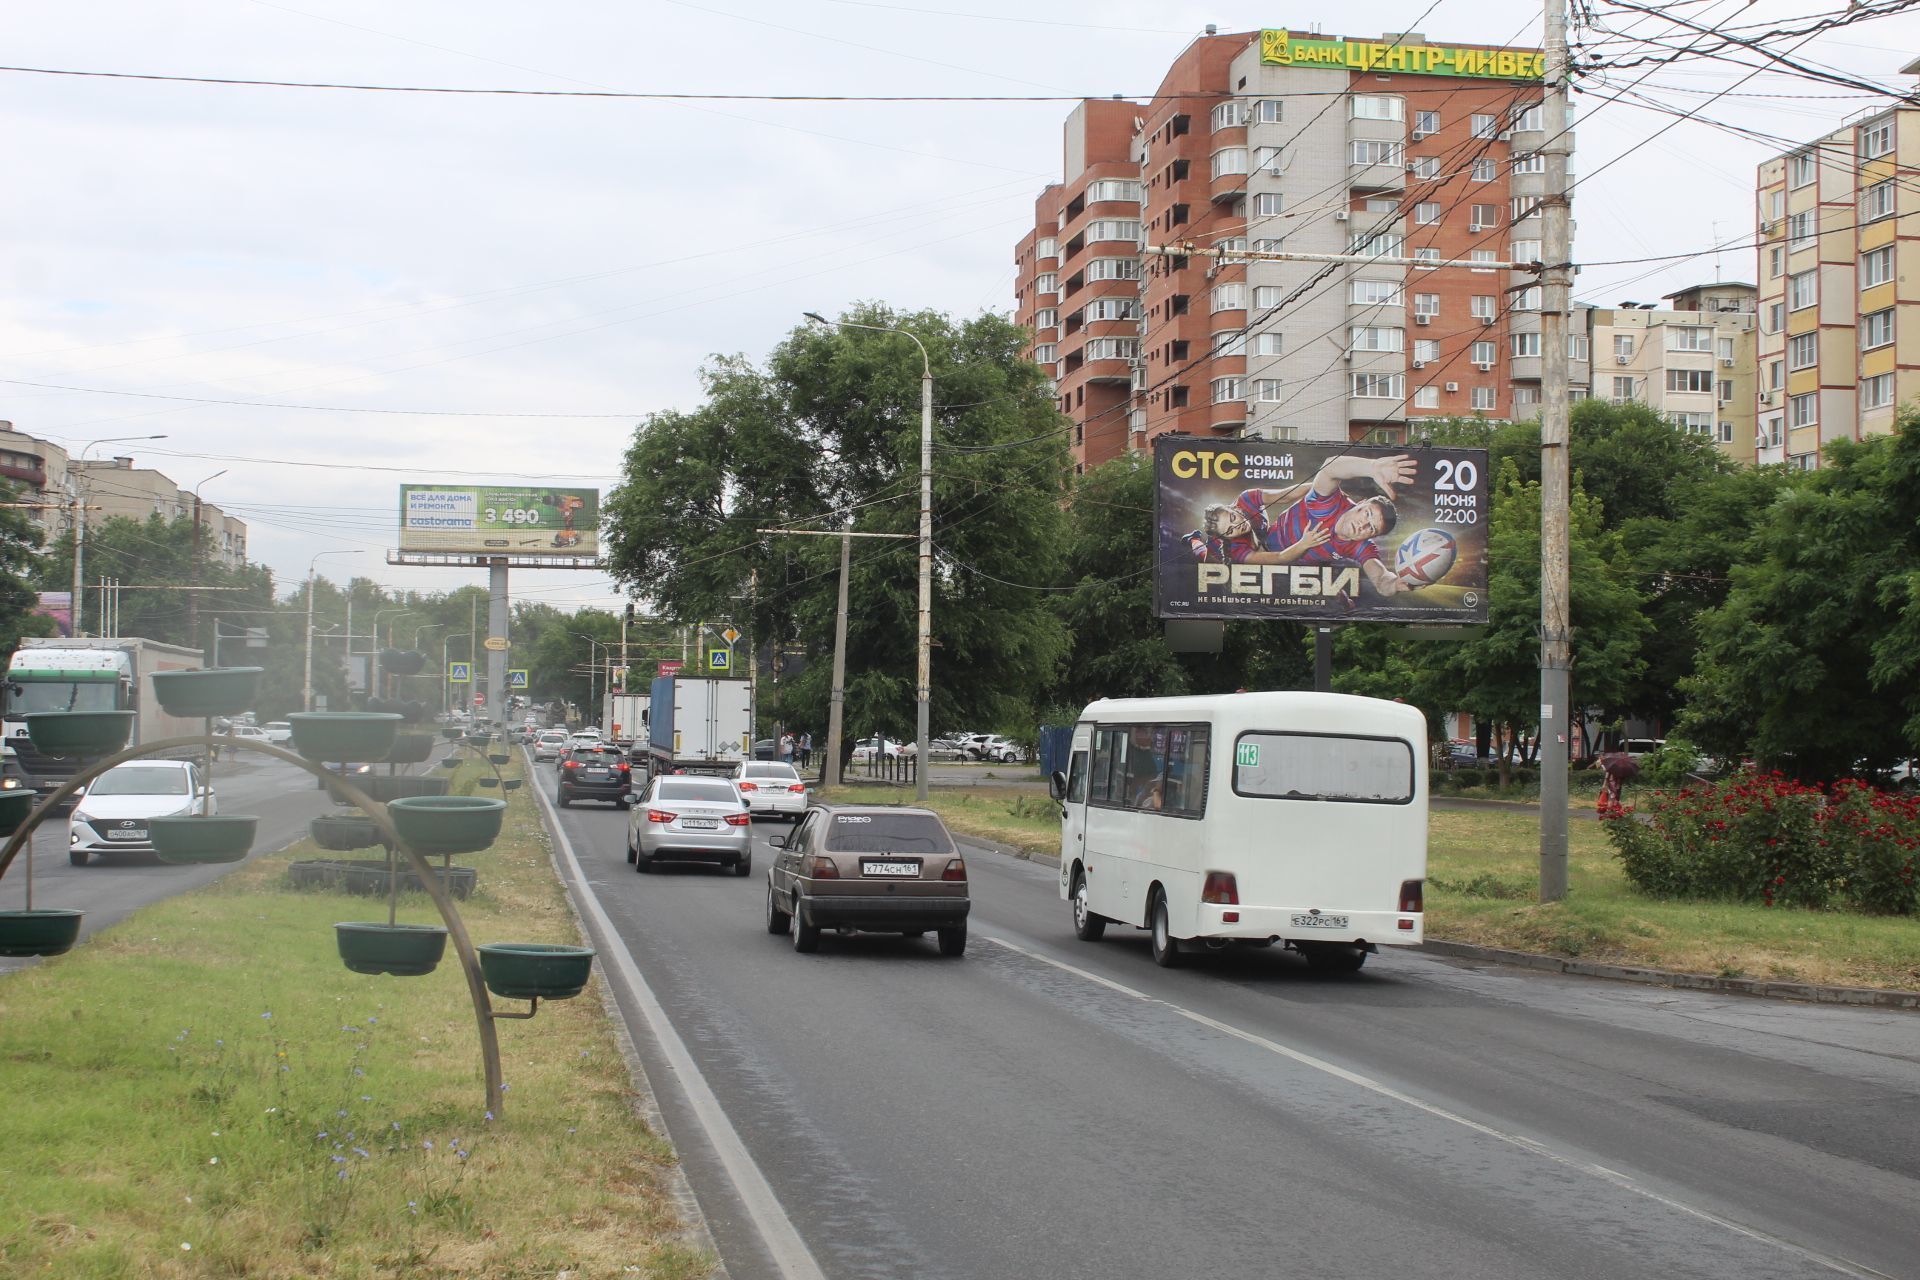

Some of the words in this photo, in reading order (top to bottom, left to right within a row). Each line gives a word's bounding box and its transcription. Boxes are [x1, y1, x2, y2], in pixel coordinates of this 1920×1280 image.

[1294, 45, 1343, 64] БАНК
[1346, 41, 1544, 77] ЦЕНТР-ИНВЕС
[1171, 450, 1239, 480] СТС
[1244, 453, 1294, 467] НОВЫЙ
[1244, 468, 1294, 480] СЕРИАЛ
[1434, 459, 1478, 491] 20
[427, 494, 446, 502] ДЛЯ
[1434, 493, 1476, 507] ИЮНЯ
[418, 503, 456, 511] РЕМОНТА
[410, 516, 472, 526] castorama
[485, 508, 496, 524] 3
[502, 508, 539, 525] 490
[1434, 508, 1477, 524] 22:00
[1198, 563, 1359, 597] РЕГБИ
[1211, 595, 1251, 604] БЬЁШЬСЯ
[1239, 745, 1257, 764] 113
